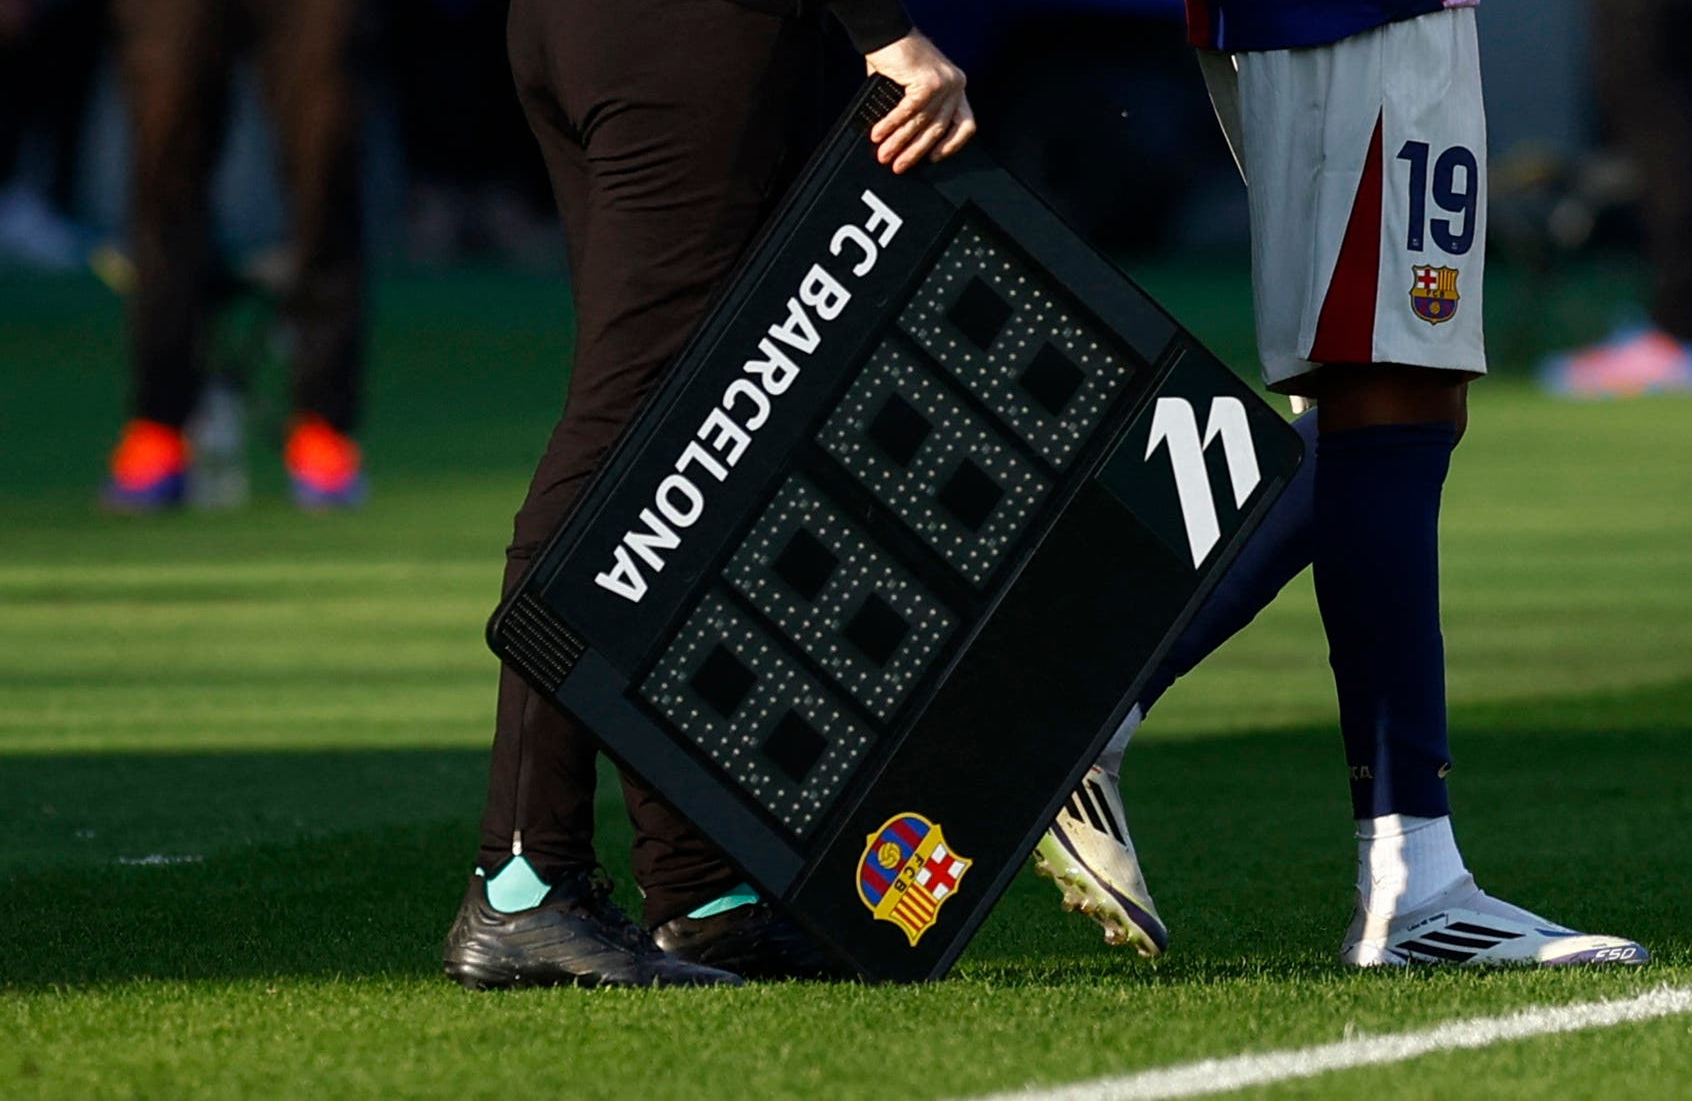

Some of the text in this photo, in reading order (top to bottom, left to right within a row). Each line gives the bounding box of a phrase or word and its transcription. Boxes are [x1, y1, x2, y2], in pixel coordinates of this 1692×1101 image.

[1396, 140, 1479, 256] 19
[594, 189, 903, 603] FC BARCELONA
[894, 853, 924, 892] FCB
